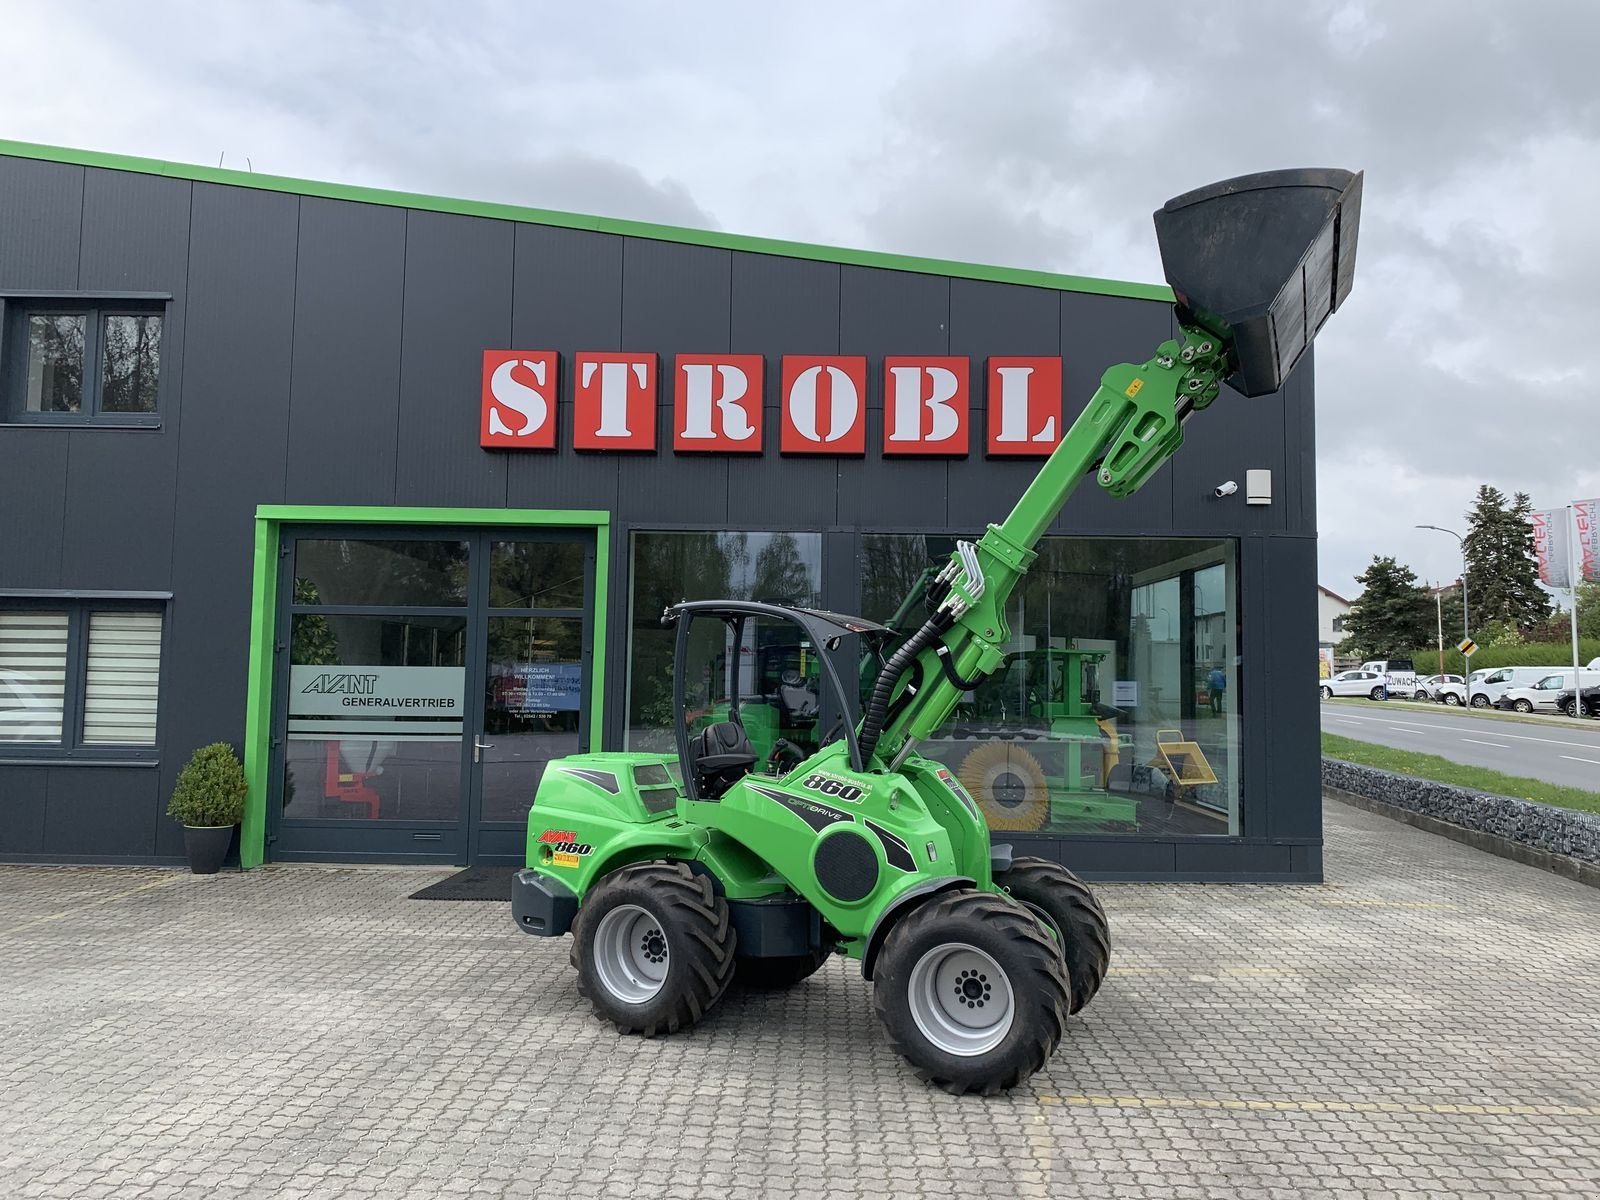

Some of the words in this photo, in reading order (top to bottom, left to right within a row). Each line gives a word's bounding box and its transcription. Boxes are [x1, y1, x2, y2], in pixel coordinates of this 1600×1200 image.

[488, 359, 1056, 443] STROBL
[301, 674, 377, 694] AVANT
[342, 697, 455, 708] GENERALVERTRIEB
